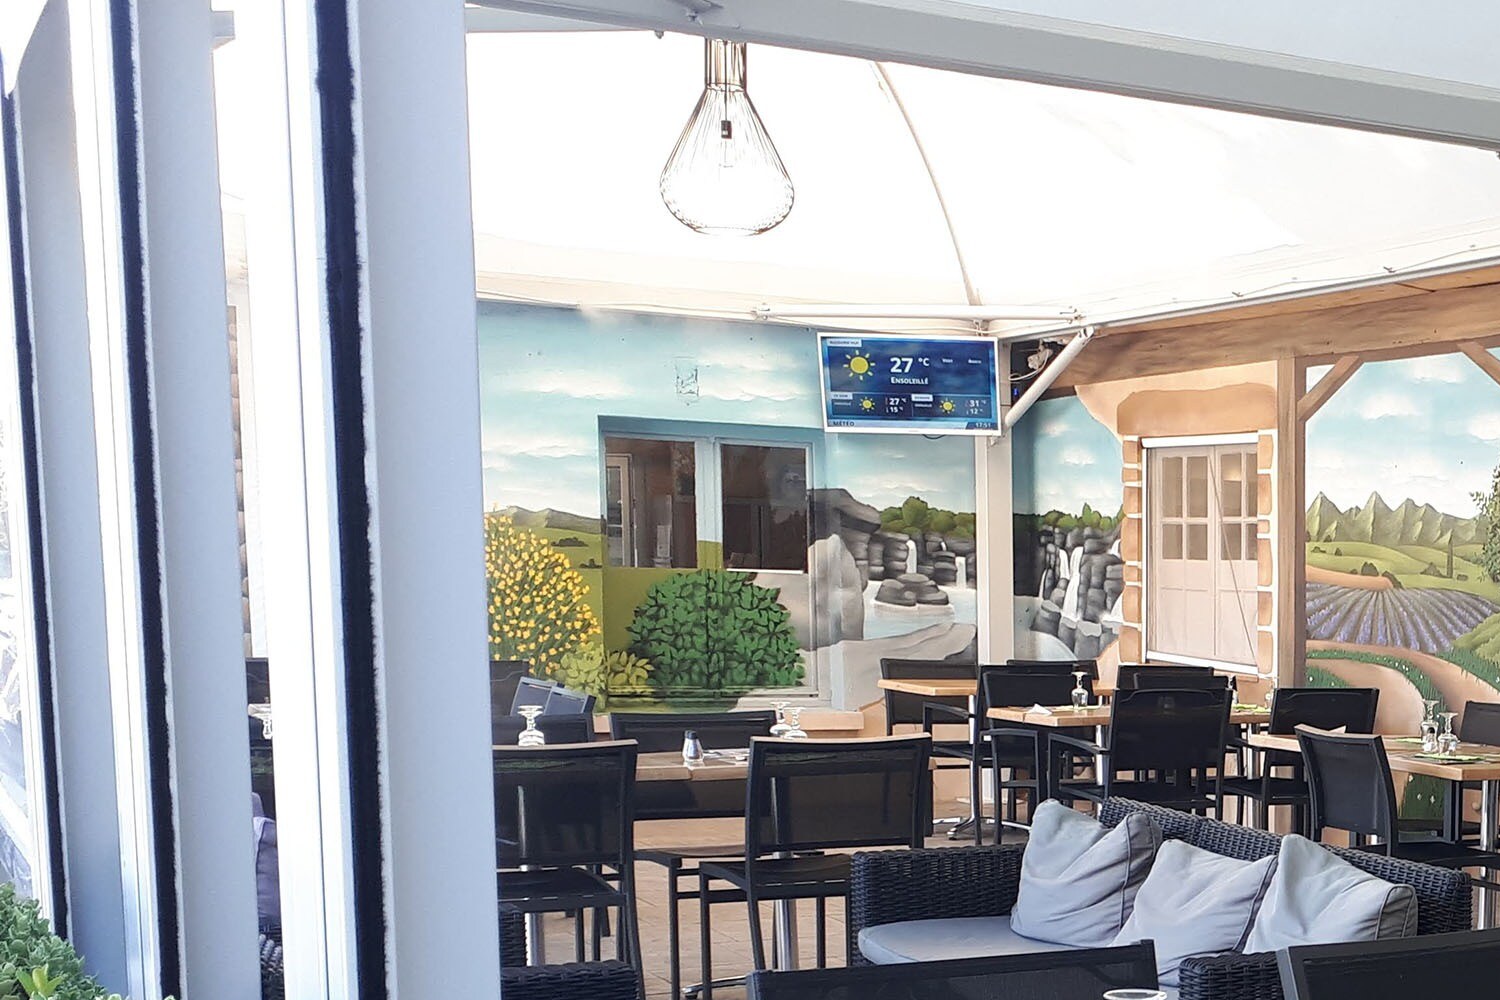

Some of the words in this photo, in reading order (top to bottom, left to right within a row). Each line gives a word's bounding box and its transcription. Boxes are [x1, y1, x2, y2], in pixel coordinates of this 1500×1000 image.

[890, 357, 913, 373] 27
[918, 357, 930, 367] °C
[889, 397, 900, 406] 27
